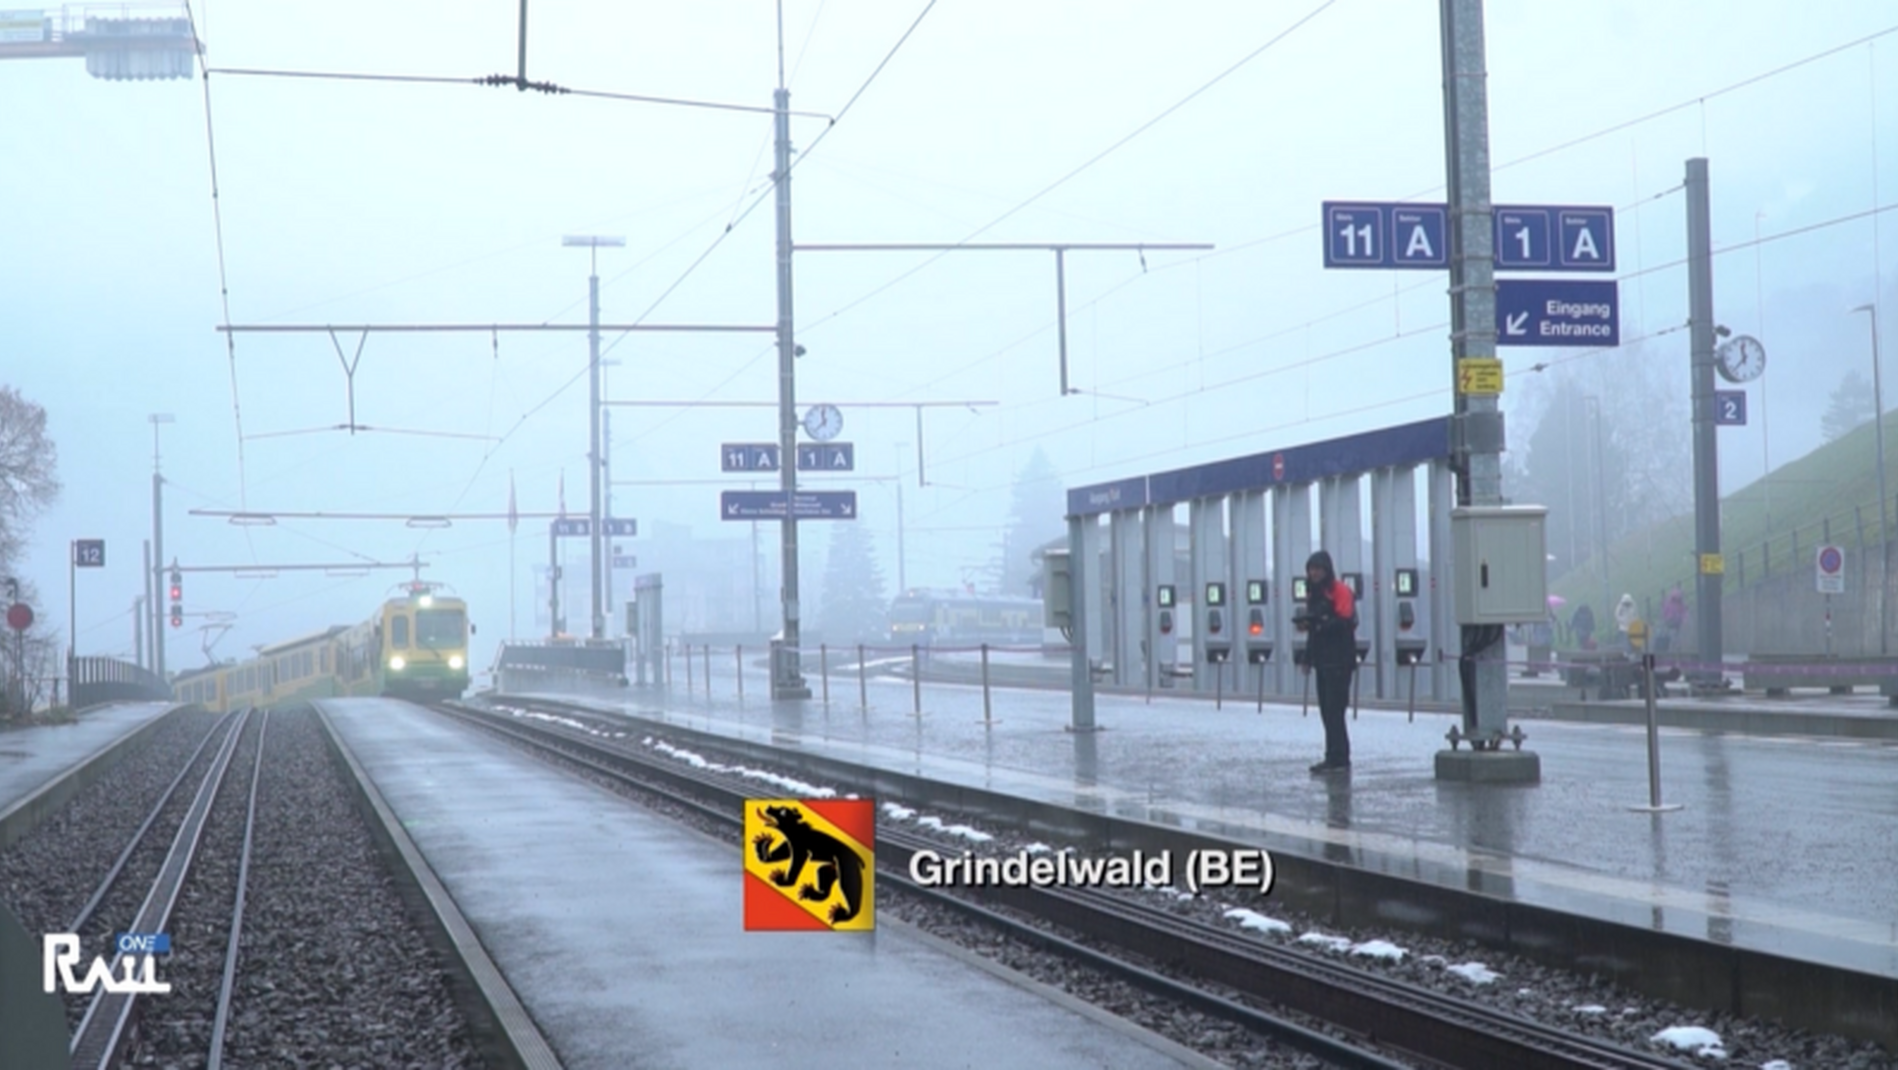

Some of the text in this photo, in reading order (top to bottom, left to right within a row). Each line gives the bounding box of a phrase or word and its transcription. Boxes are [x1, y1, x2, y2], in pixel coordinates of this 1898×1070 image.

[1340, 224, 1434, 257] 11 A
[1515, 226, 1599, 259] 1 A
[1546, 300, 1611, 319] Eingang
[1540, 320, 1611, 337] Entrance
[1725, 401, 1737, 419] 2
[729, 452, 771, 467] 11 A
[807, 451, 847, 467] 1 A
[82, 548, 100, 563] 12
